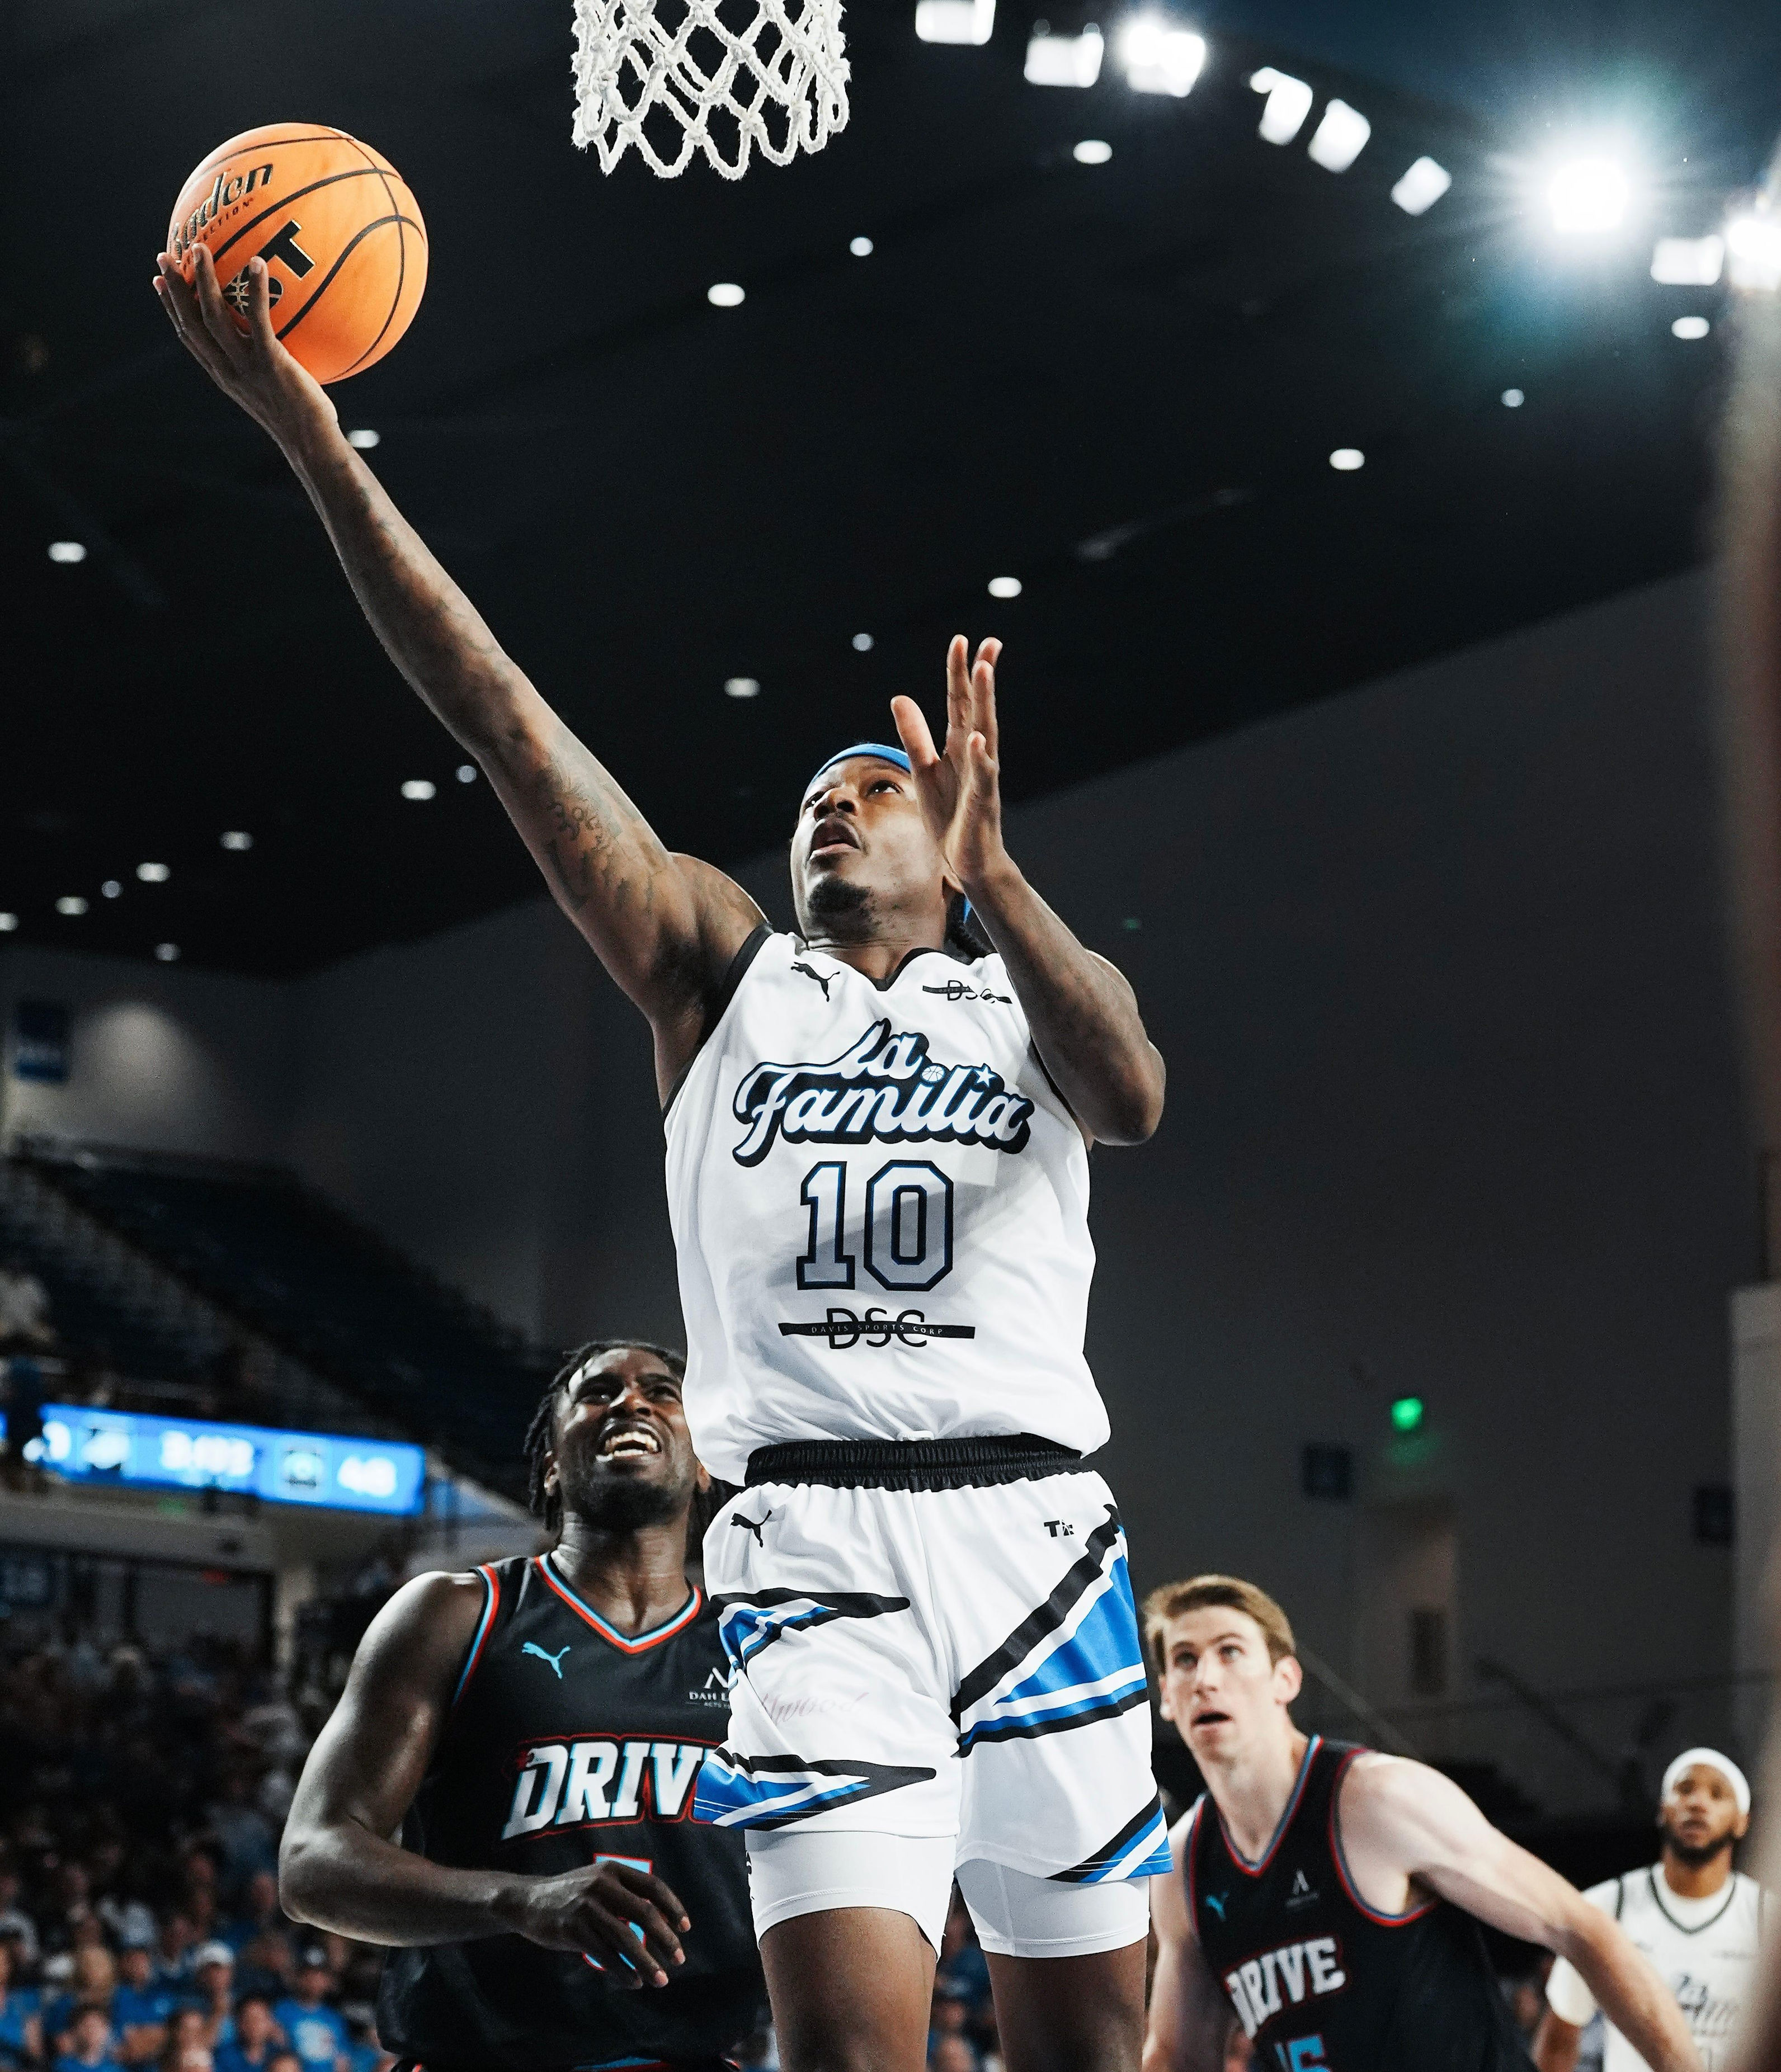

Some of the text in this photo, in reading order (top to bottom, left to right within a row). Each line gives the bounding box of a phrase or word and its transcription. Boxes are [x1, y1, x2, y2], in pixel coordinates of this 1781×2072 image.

[732, 1061, 1035, 1167] Familia
[796, 1159, 954, 1292] 10
[811, 1325, 849, 1333] DAVIS
[912, 1325, 944, 1335] CORP
[826, 1308, 927, 1349] DSC
[501, 1741, 715, 1841] DRIV
